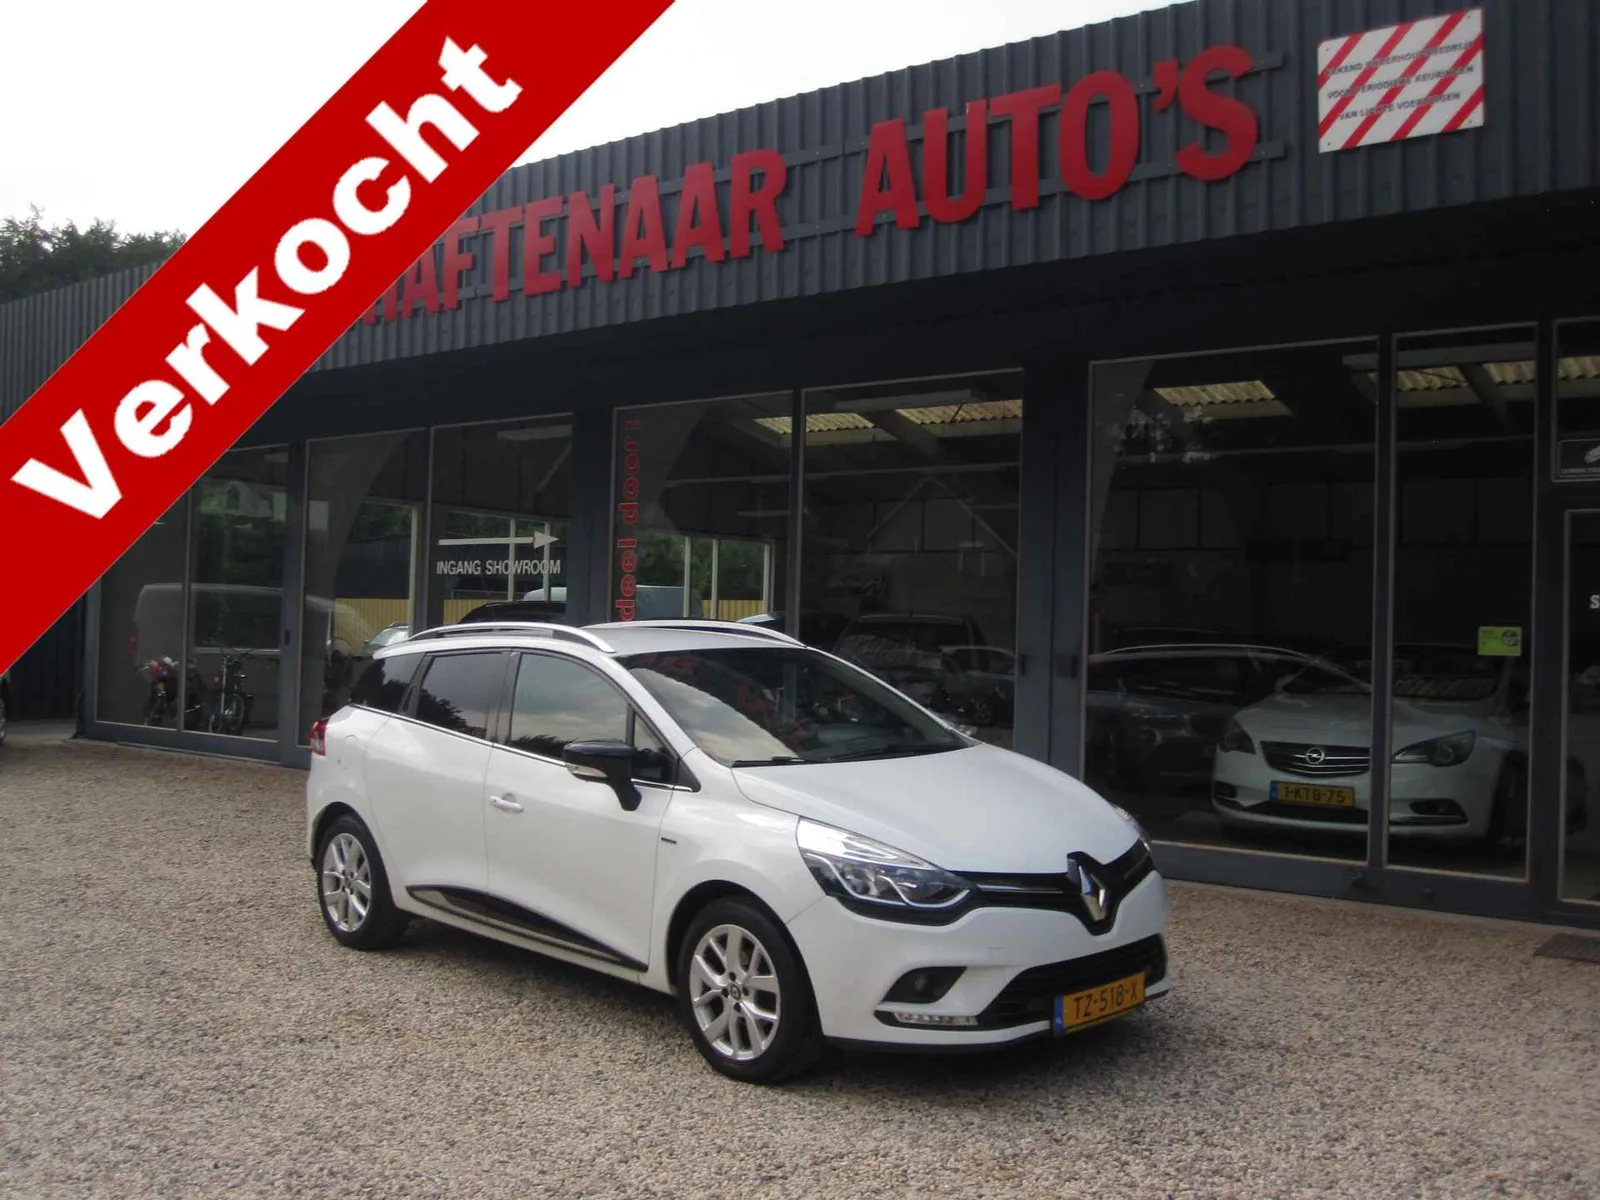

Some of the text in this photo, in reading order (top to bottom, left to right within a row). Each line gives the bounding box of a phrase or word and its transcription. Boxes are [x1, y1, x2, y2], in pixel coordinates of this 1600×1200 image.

[854, 44, 1258, 238] AUTO'S
[436, 559, 561, 575] INGANG SHOWROOM
[1073, 979, 1139, 1020] TZ-518-X
